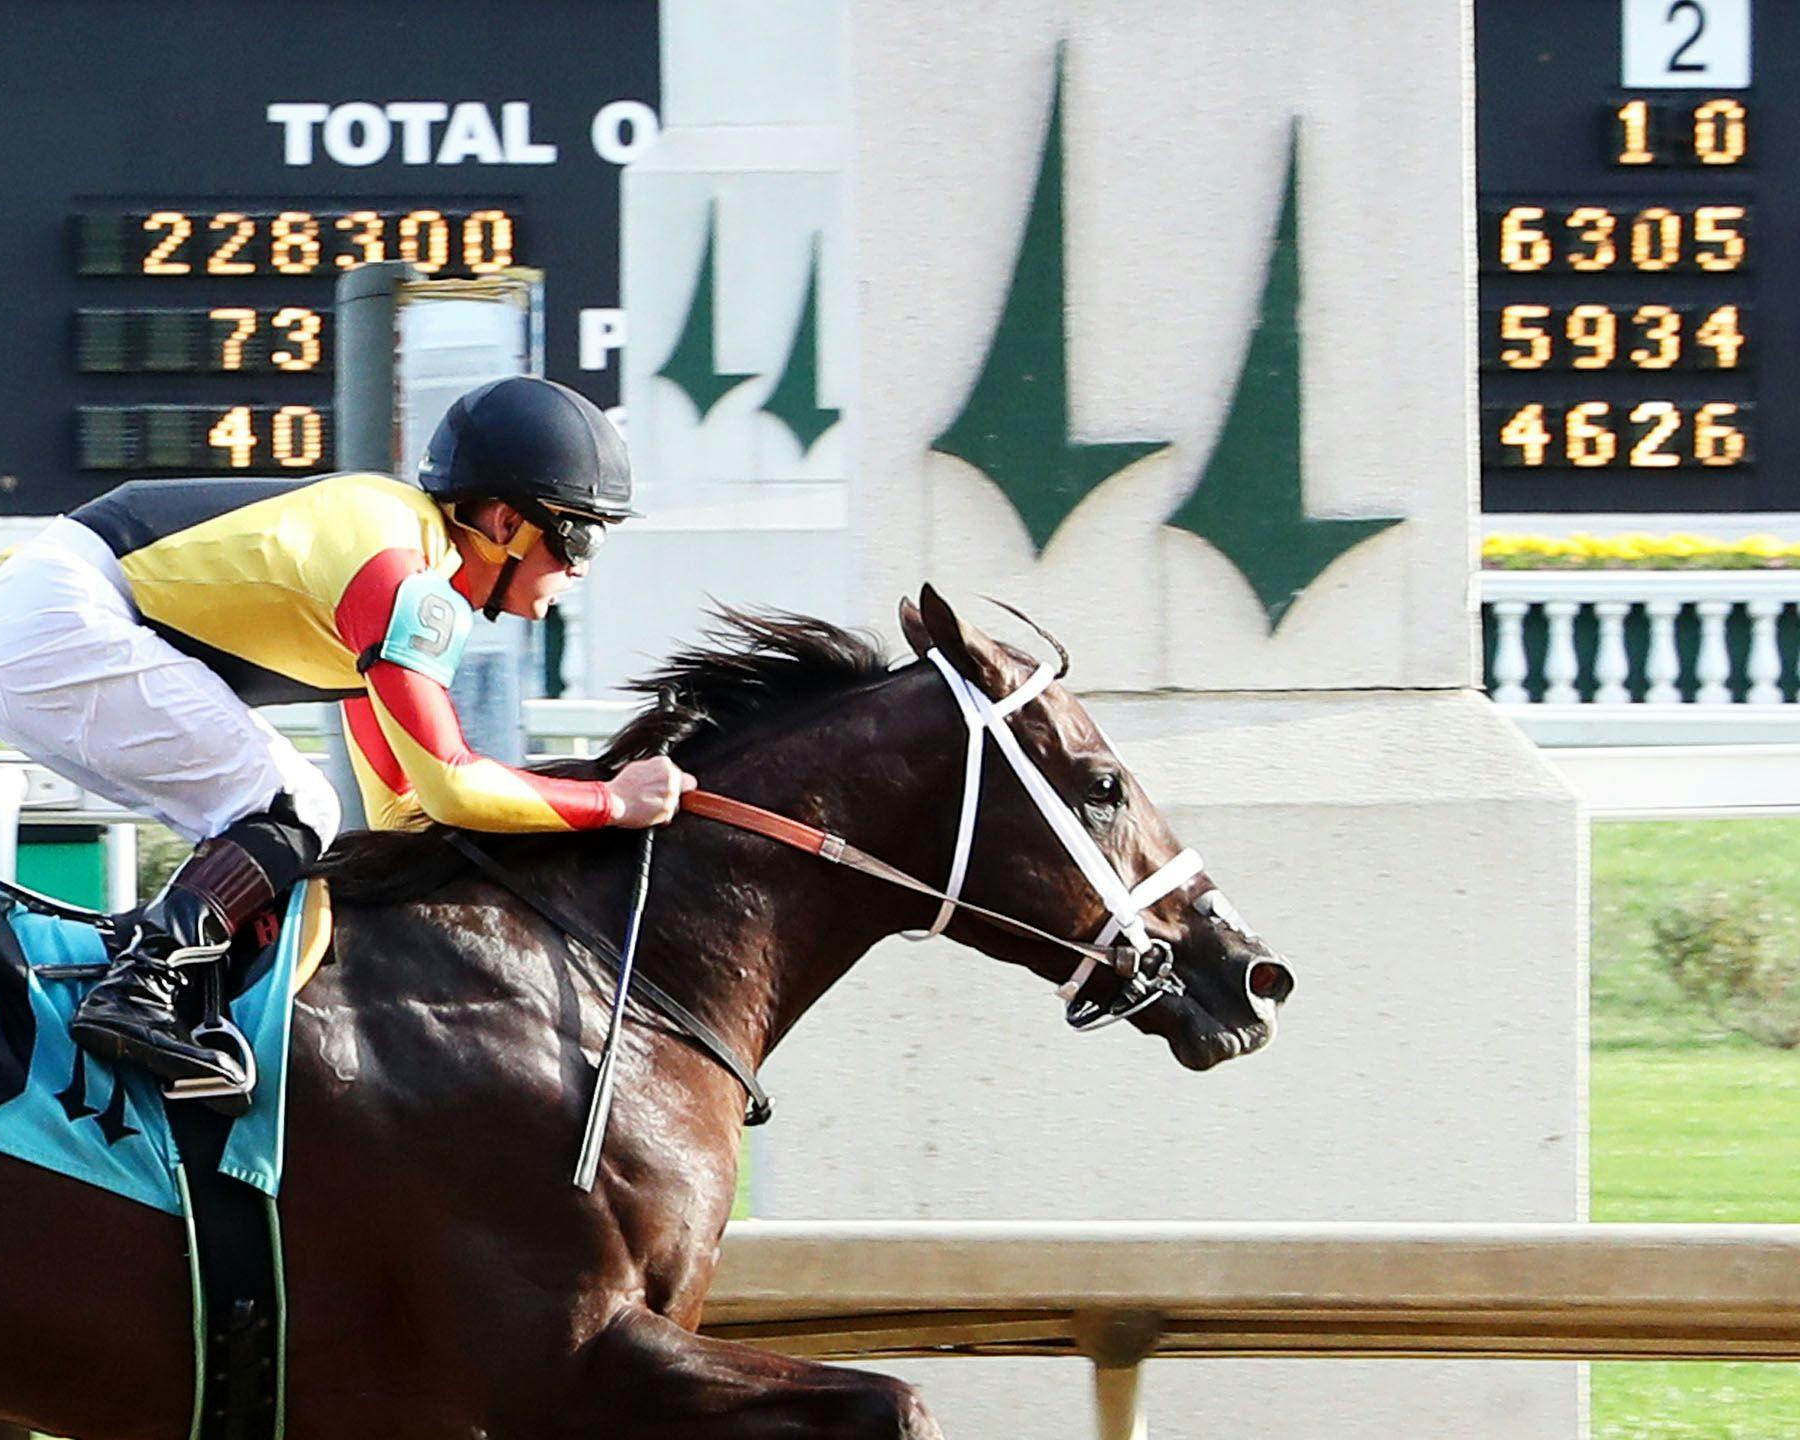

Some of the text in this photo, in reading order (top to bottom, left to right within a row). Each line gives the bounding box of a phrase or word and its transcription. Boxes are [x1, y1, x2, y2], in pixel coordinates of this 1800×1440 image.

[1665, 0, 1707, 73] 2
[267, 103, 557, 166] TOTAL
[142, 210, 515, 275] 228300
[1500, 206, 1747, 271] 6305
[208, 307, 322, 371] 73
[1500, 304, 1746, 369] 5934
[208, 405, 323, 468] 40
[1500, 402, 1747, 466] 4626
[409, 593, 456, 657] 9
